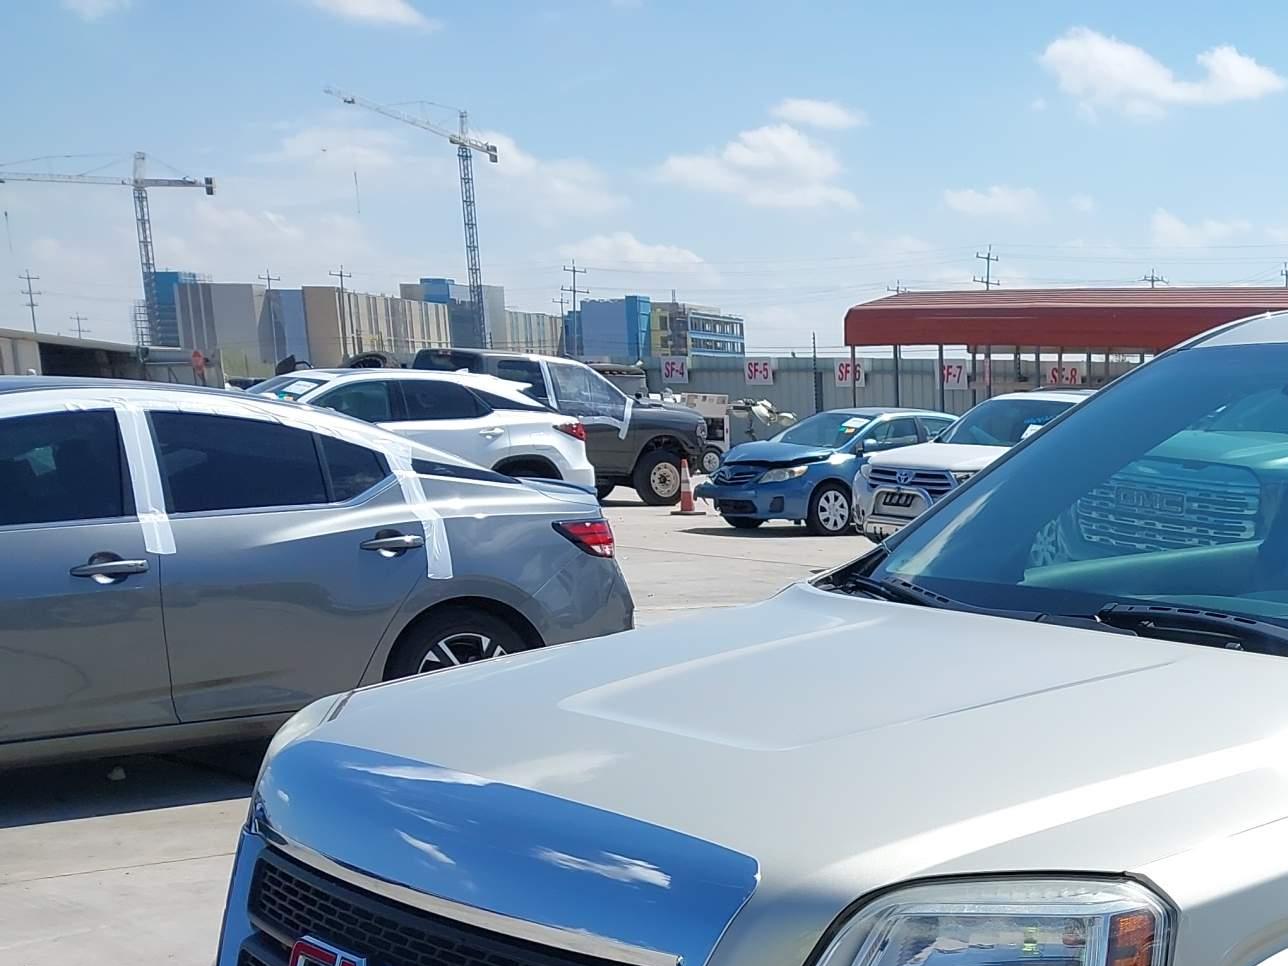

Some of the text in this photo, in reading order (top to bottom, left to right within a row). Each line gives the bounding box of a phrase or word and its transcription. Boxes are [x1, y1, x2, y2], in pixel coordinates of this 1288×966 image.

[664, 361, 684, 378] SF-4
[747, 362, 769, 379] SF-5
[838, 363, 861, 381] SF6
[1116, 486, 1183, 515] GMC
